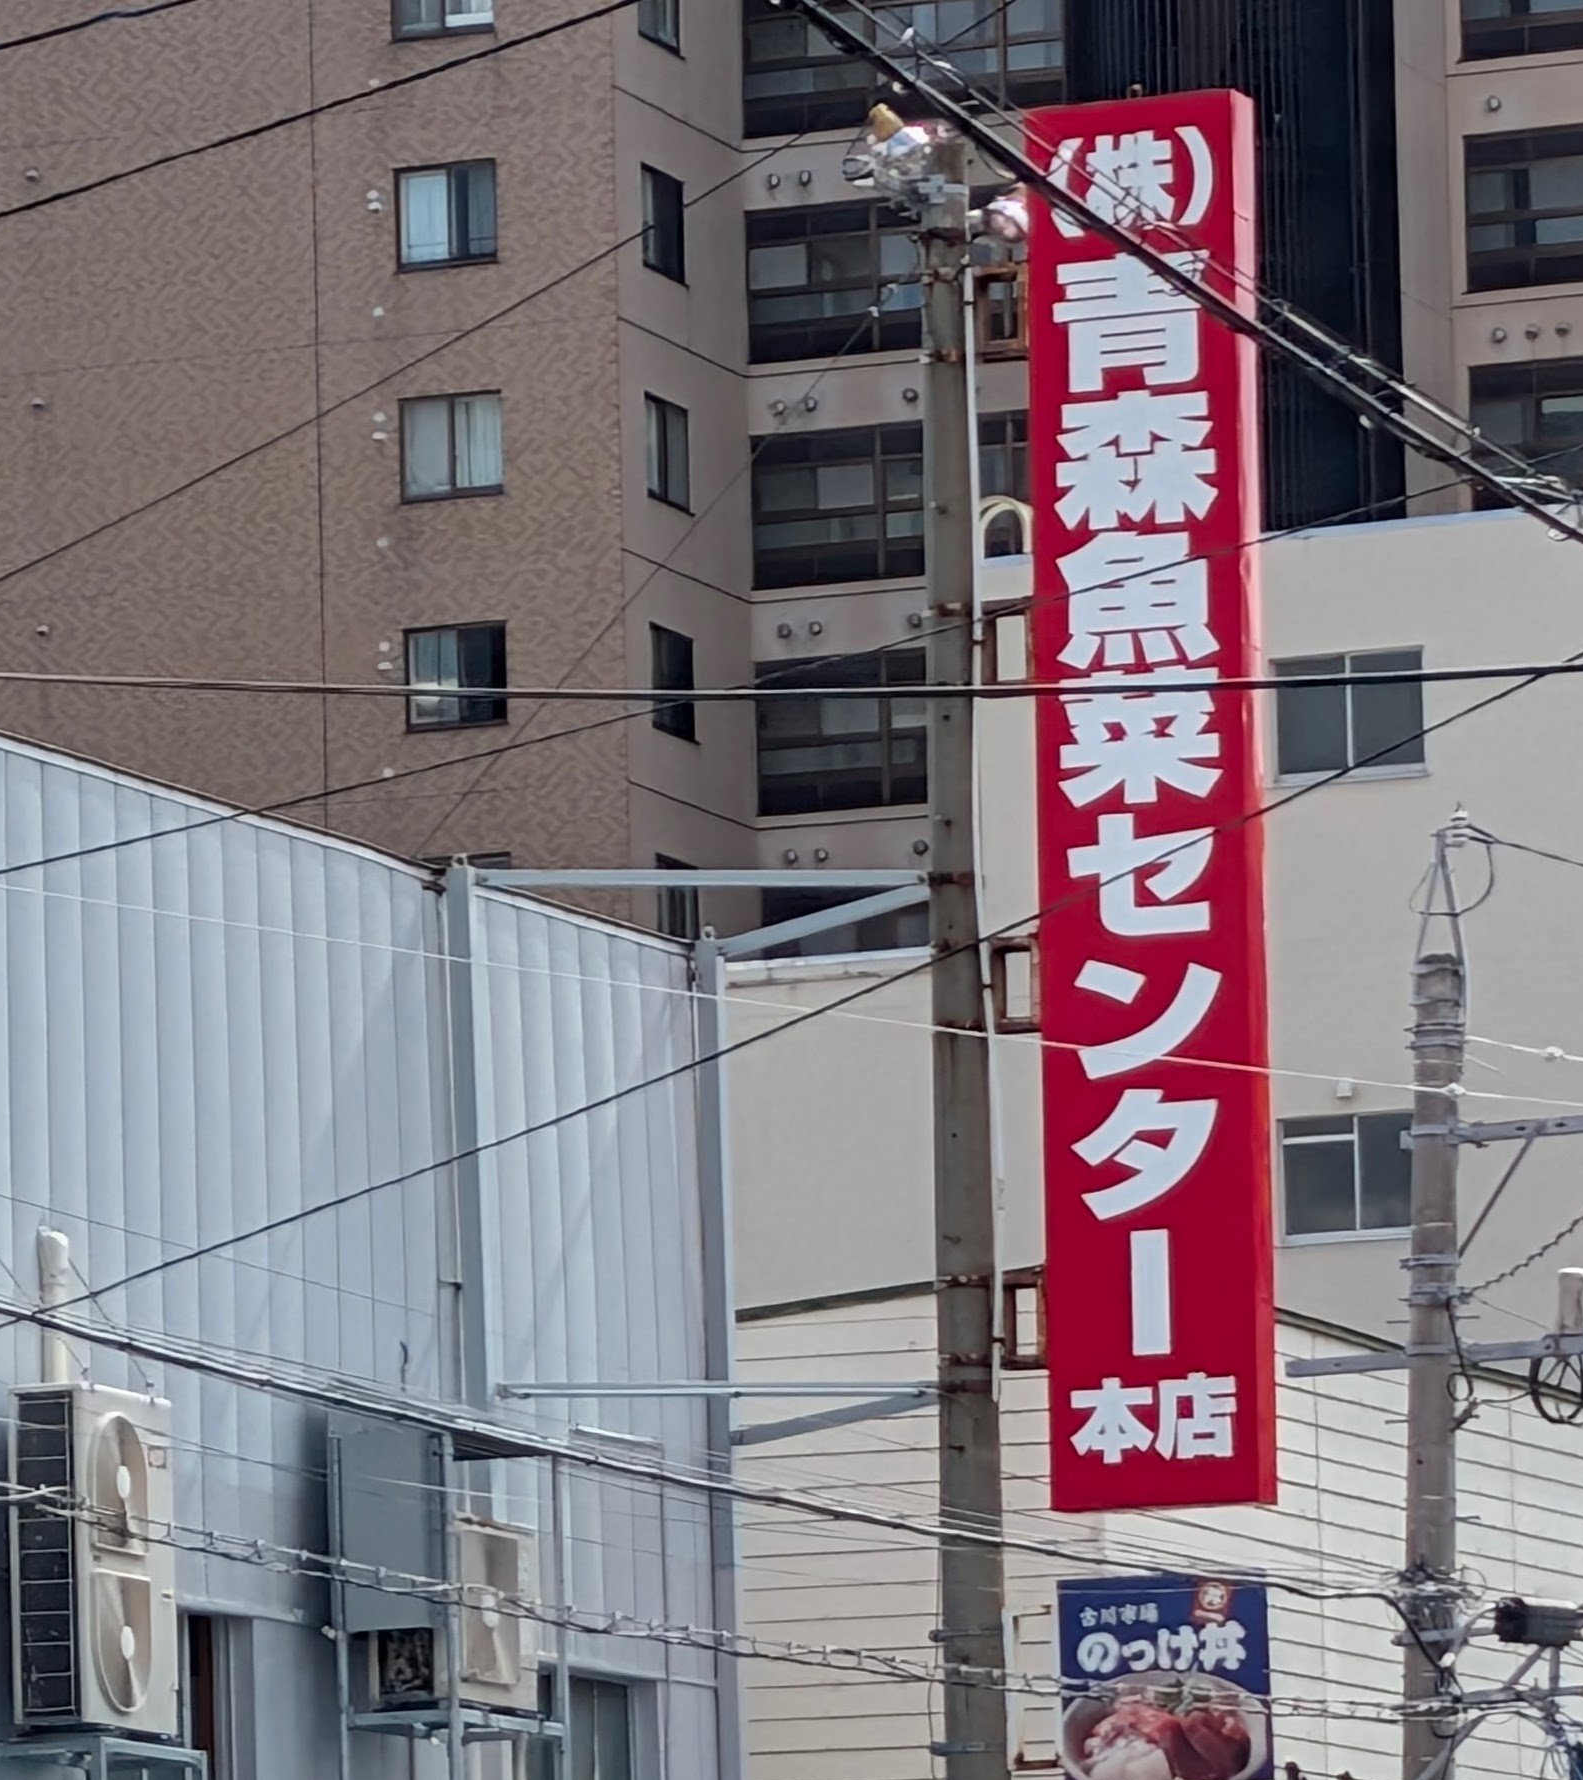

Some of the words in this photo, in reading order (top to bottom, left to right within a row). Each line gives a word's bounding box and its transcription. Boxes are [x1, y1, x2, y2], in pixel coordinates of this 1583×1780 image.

[1051, 249, 1224, 1357] 青森魚菜センター
[1069, 1371, 1237, 1464] 本店
[1076, 1620, 1247, 1674] のっけ丼
